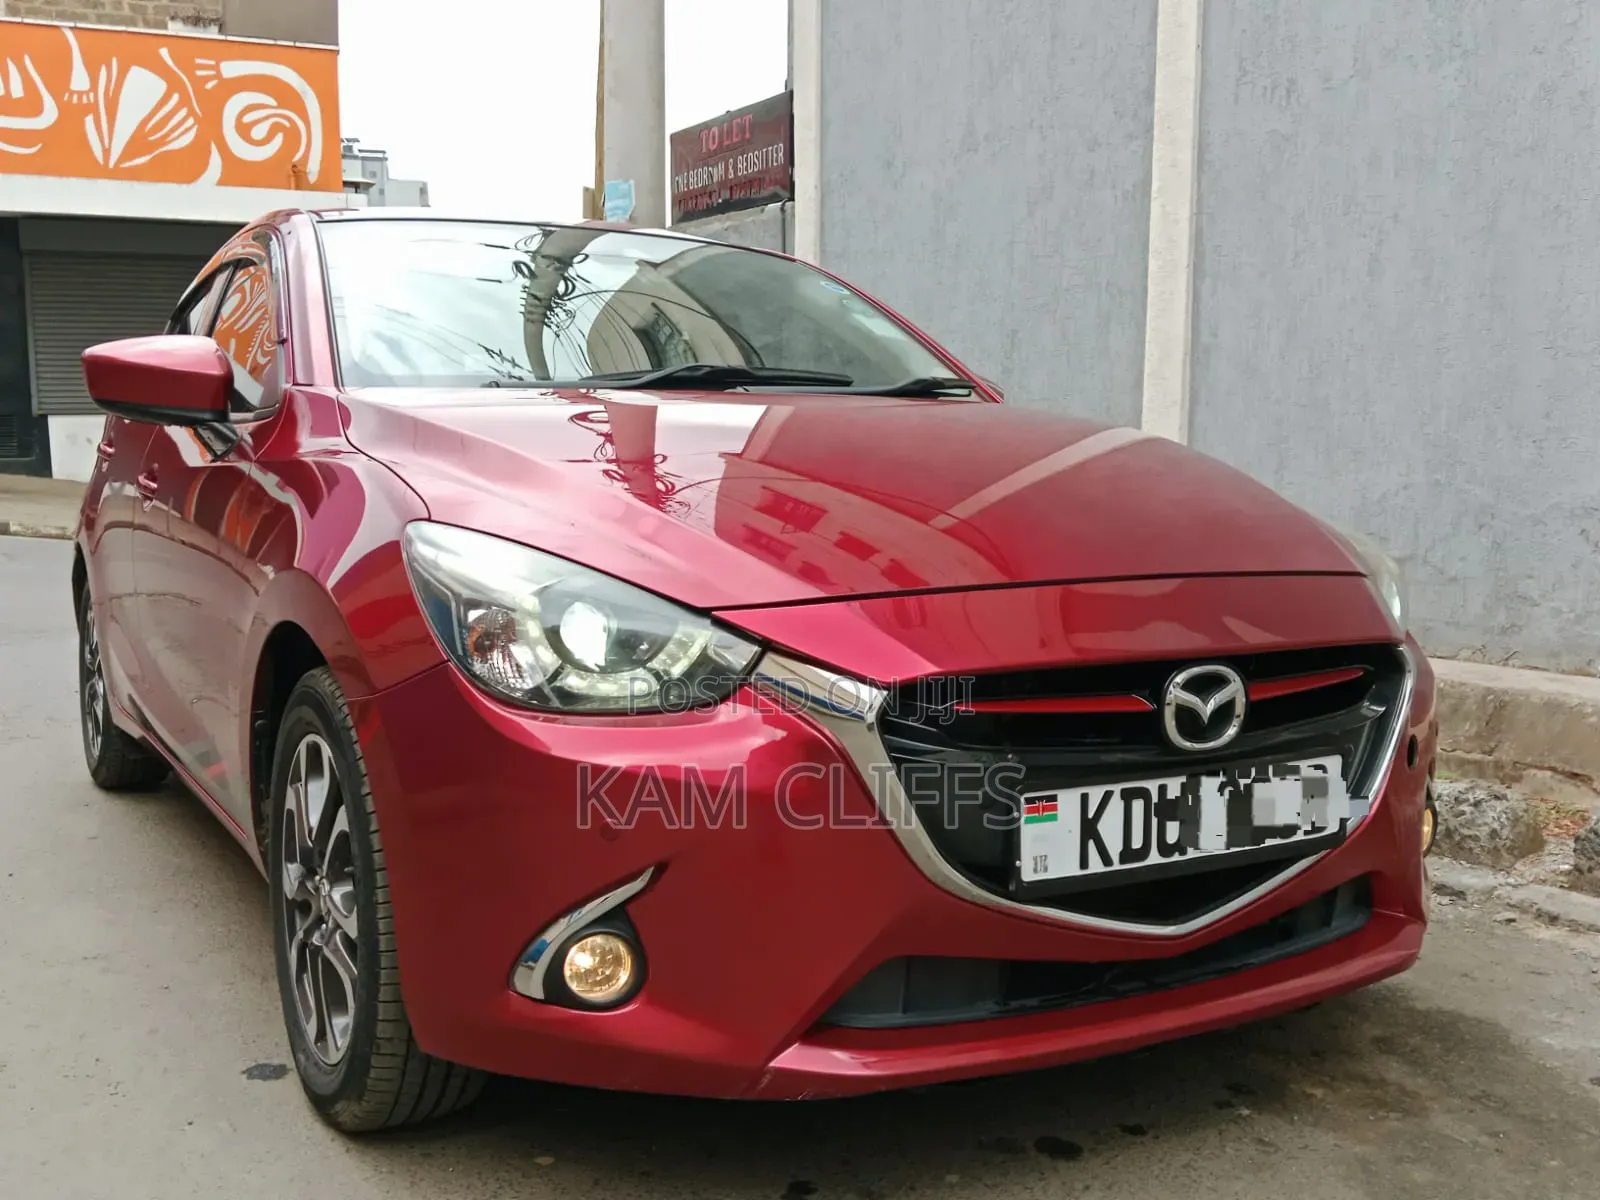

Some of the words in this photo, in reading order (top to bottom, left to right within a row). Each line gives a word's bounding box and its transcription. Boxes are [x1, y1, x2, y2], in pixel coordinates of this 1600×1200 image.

[700, 126, 719, 153] TO
[722, 113, 752, 145] LET
[728, 158, 734, 179] &
[737, 143, 784, 177] BEDSITTER
